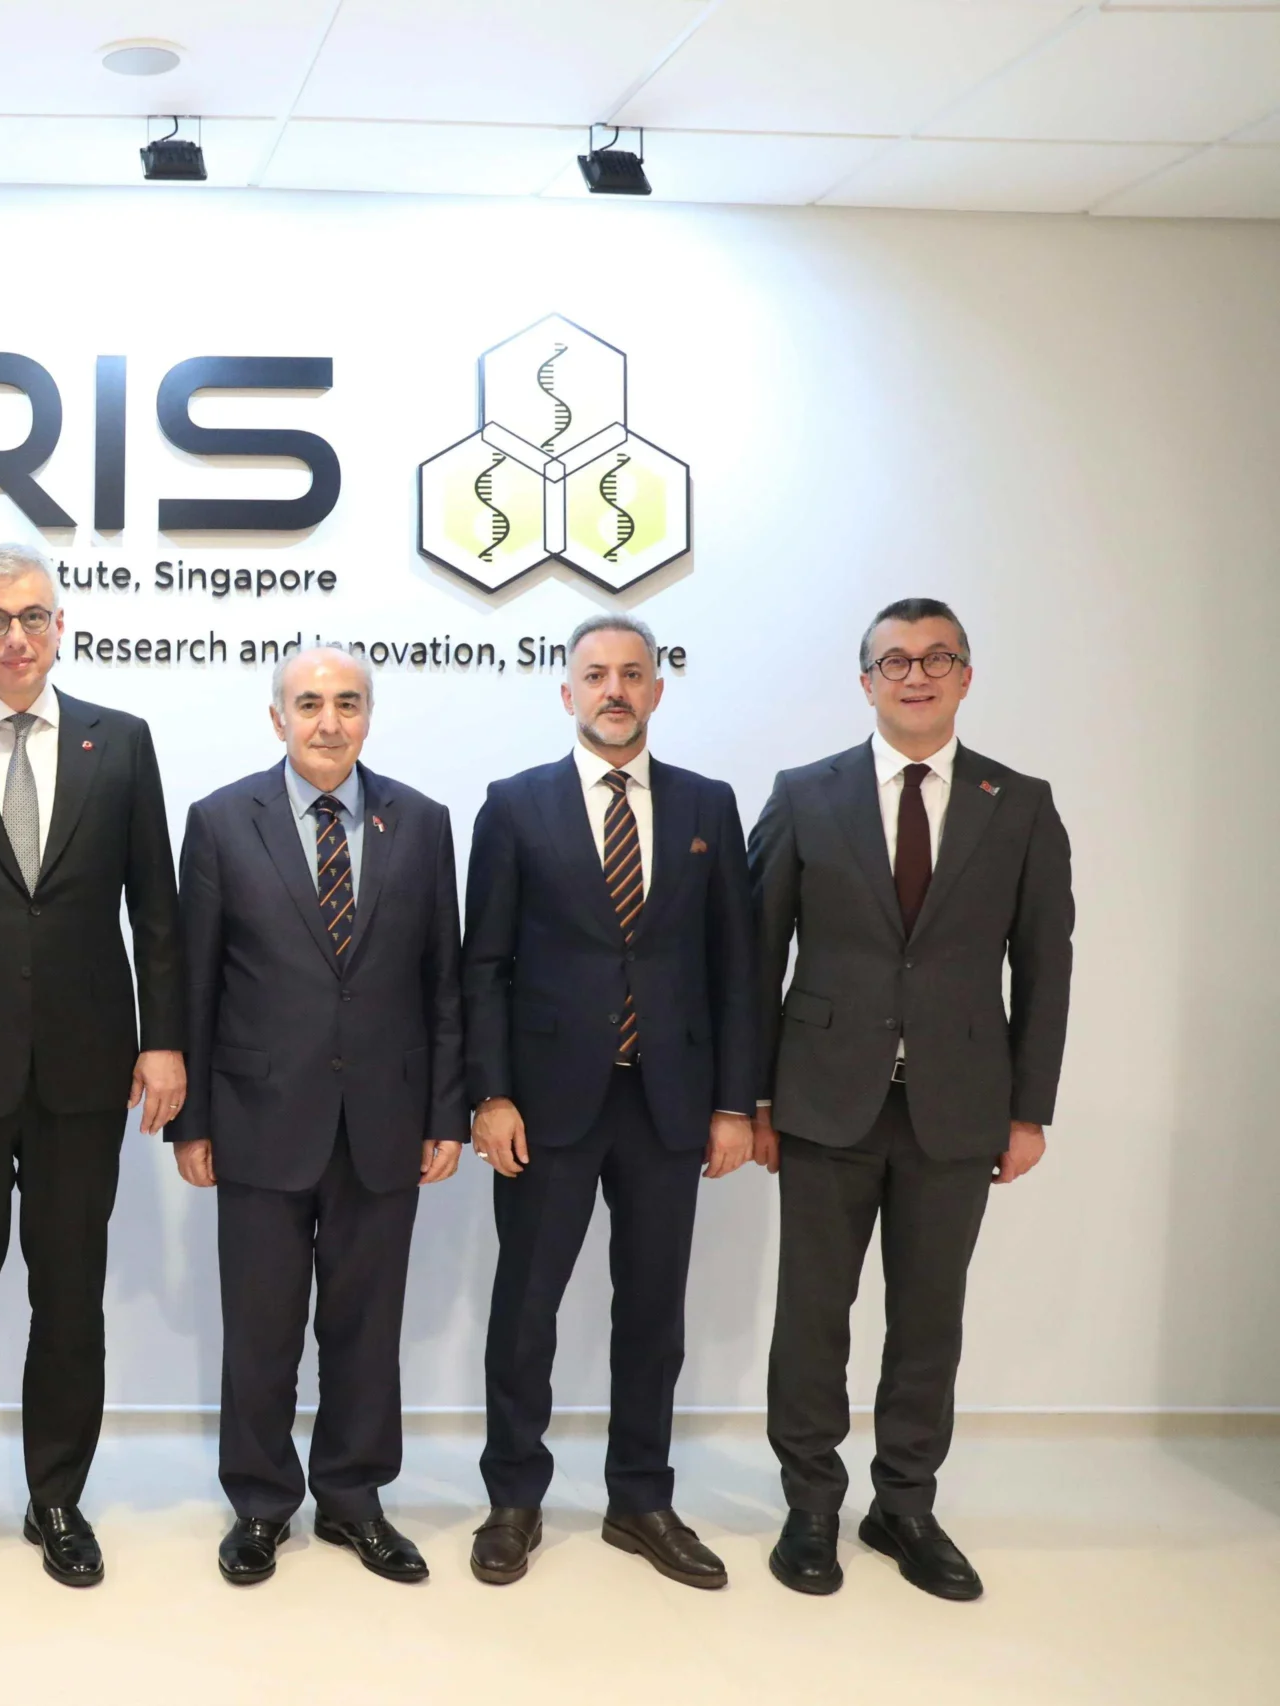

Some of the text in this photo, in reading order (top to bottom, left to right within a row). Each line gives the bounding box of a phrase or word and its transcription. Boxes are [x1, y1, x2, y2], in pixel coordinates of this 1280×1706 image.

[154, 559, 337, 597] Singapore
[74, 630, 227, 663] Research
[517, 635, 687, 669] Sinre
